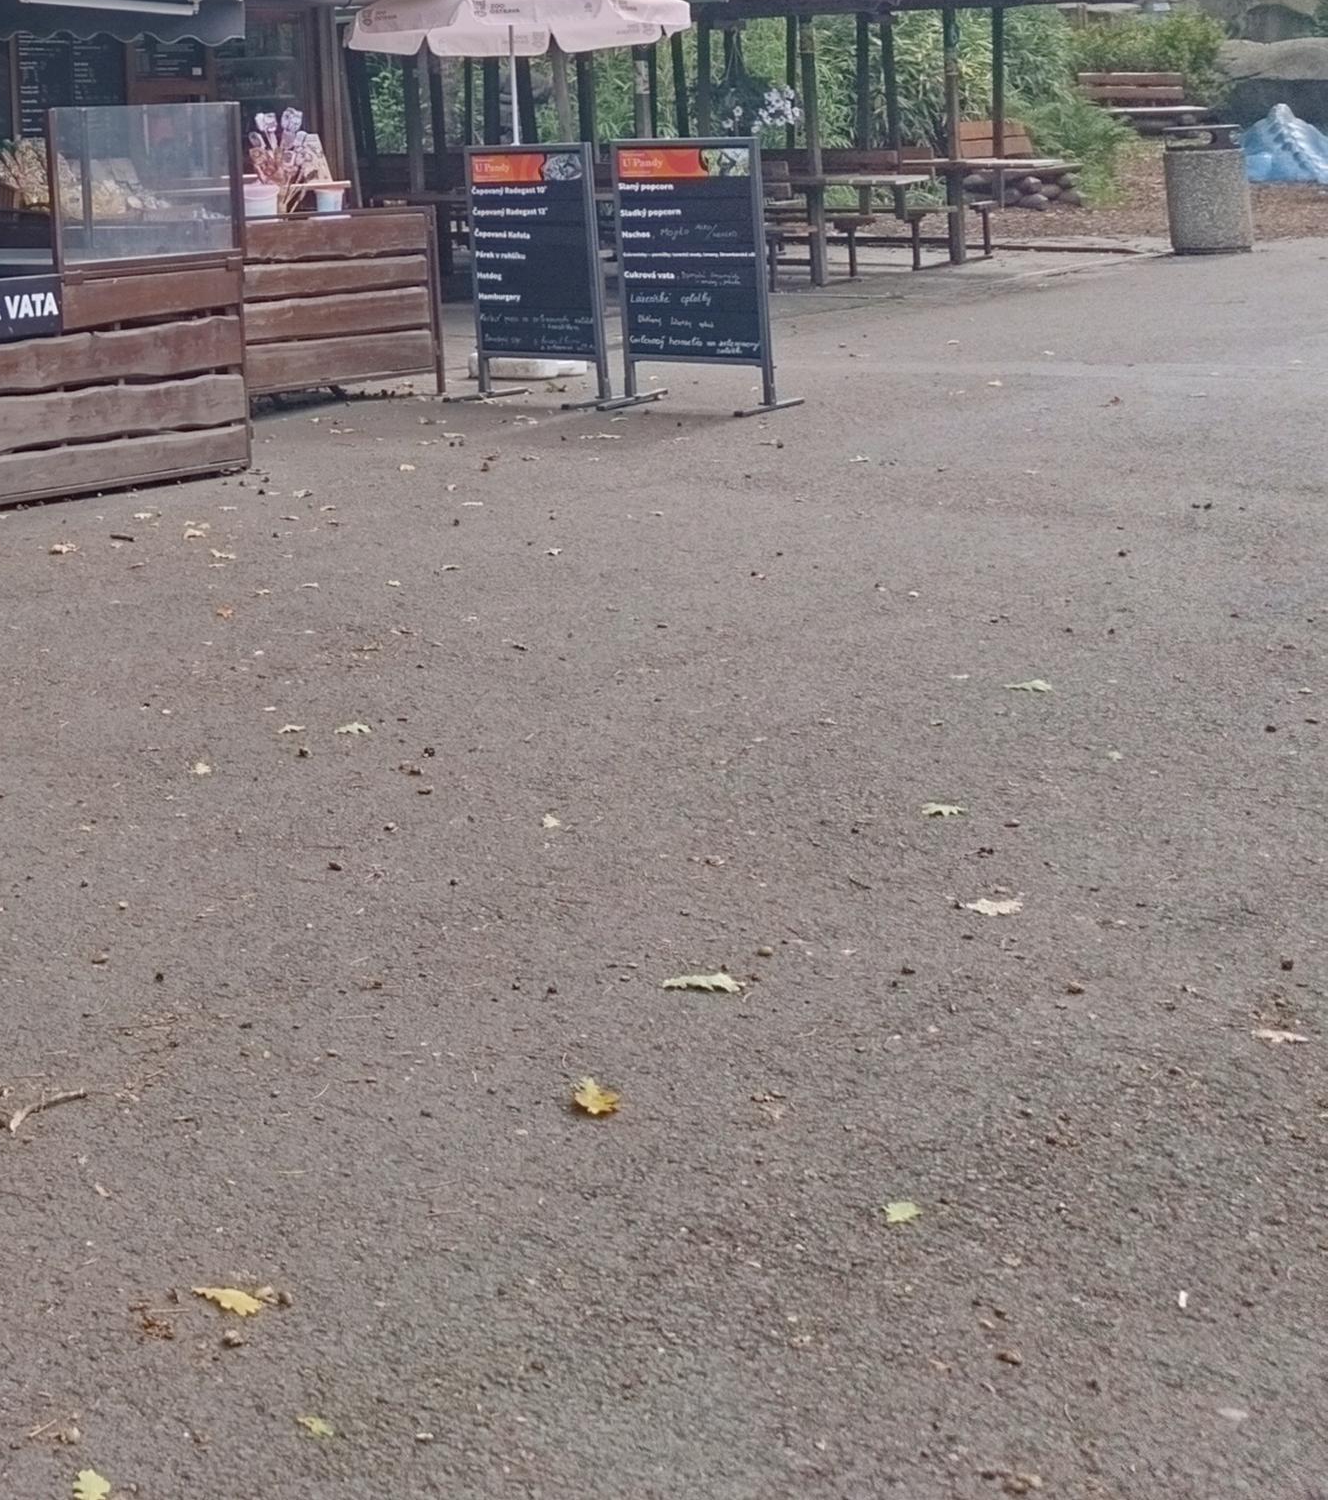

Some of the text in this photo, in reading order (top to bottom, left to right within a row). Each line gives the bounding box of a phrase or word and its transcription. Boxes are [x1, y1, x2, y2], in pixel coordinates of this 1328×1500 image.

[632, 157, 663, 169] Pandy
[471, 186, 504, 196] Čepovaný
[504, 186, 536, 196] Radegast
[618, 182, 674, 192] Slaný popcorn
[472, 207, 505, 217] Čepovaný
[505, 208, 537, 217] Radegast
[620, 208, 681, 218] Sladký popcorn
[624, 271, 656, 280] Cukrová
[657, 272, 675, 280] vata
[478, 293, 521, 302] Hamburgery
[5, 292, 59, 320] VATA
